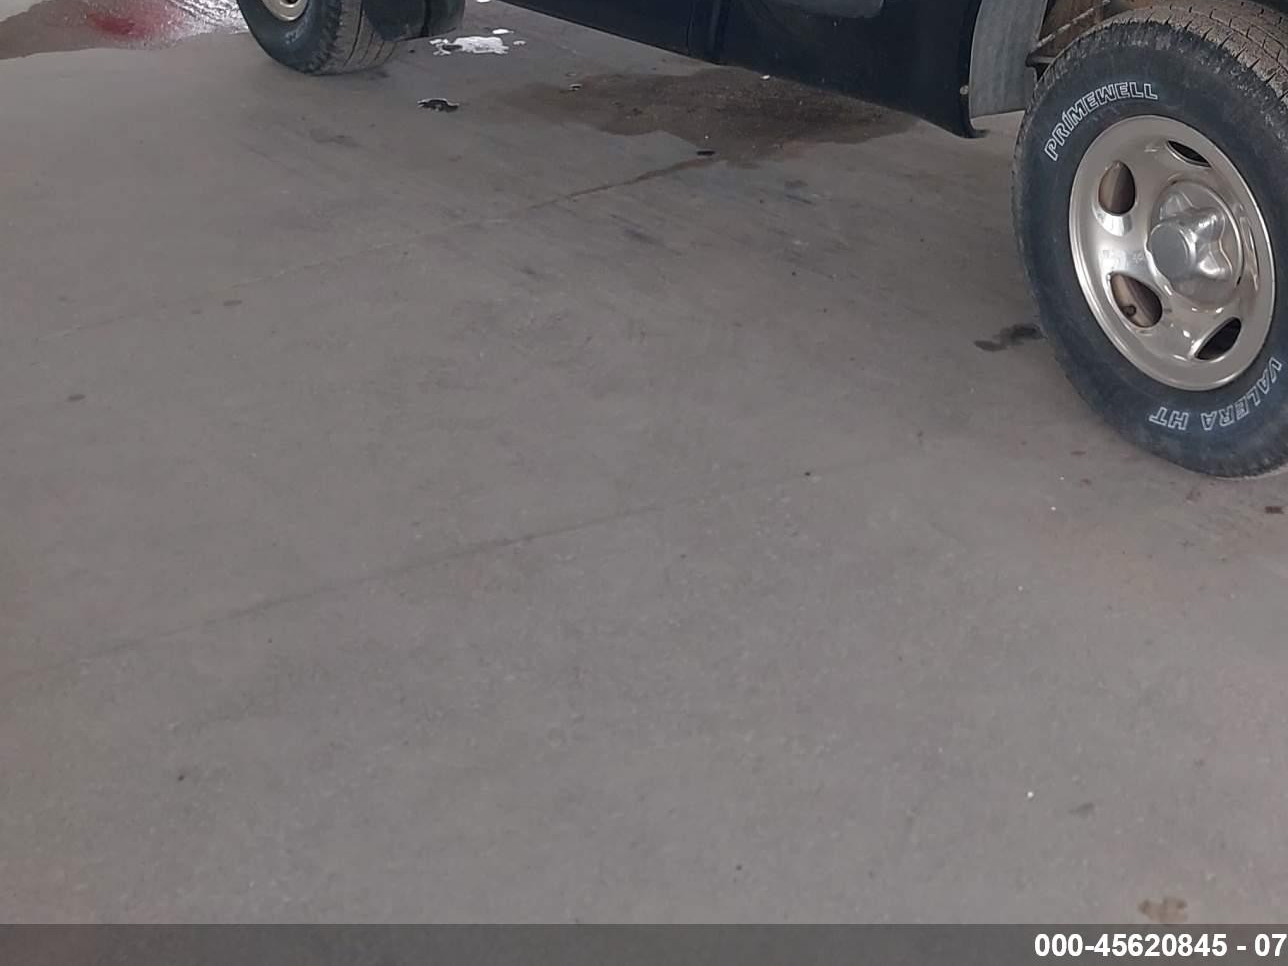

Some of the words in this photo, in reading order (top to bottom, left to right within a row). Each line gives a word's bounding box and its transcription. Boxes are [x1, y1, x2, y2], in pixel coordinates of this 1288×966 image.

[1043, 81, 1159, 162] PRIMEWELL
[1149, 406, 1190, 431] HT
[1200, 356, 1283, 431] VALERA
